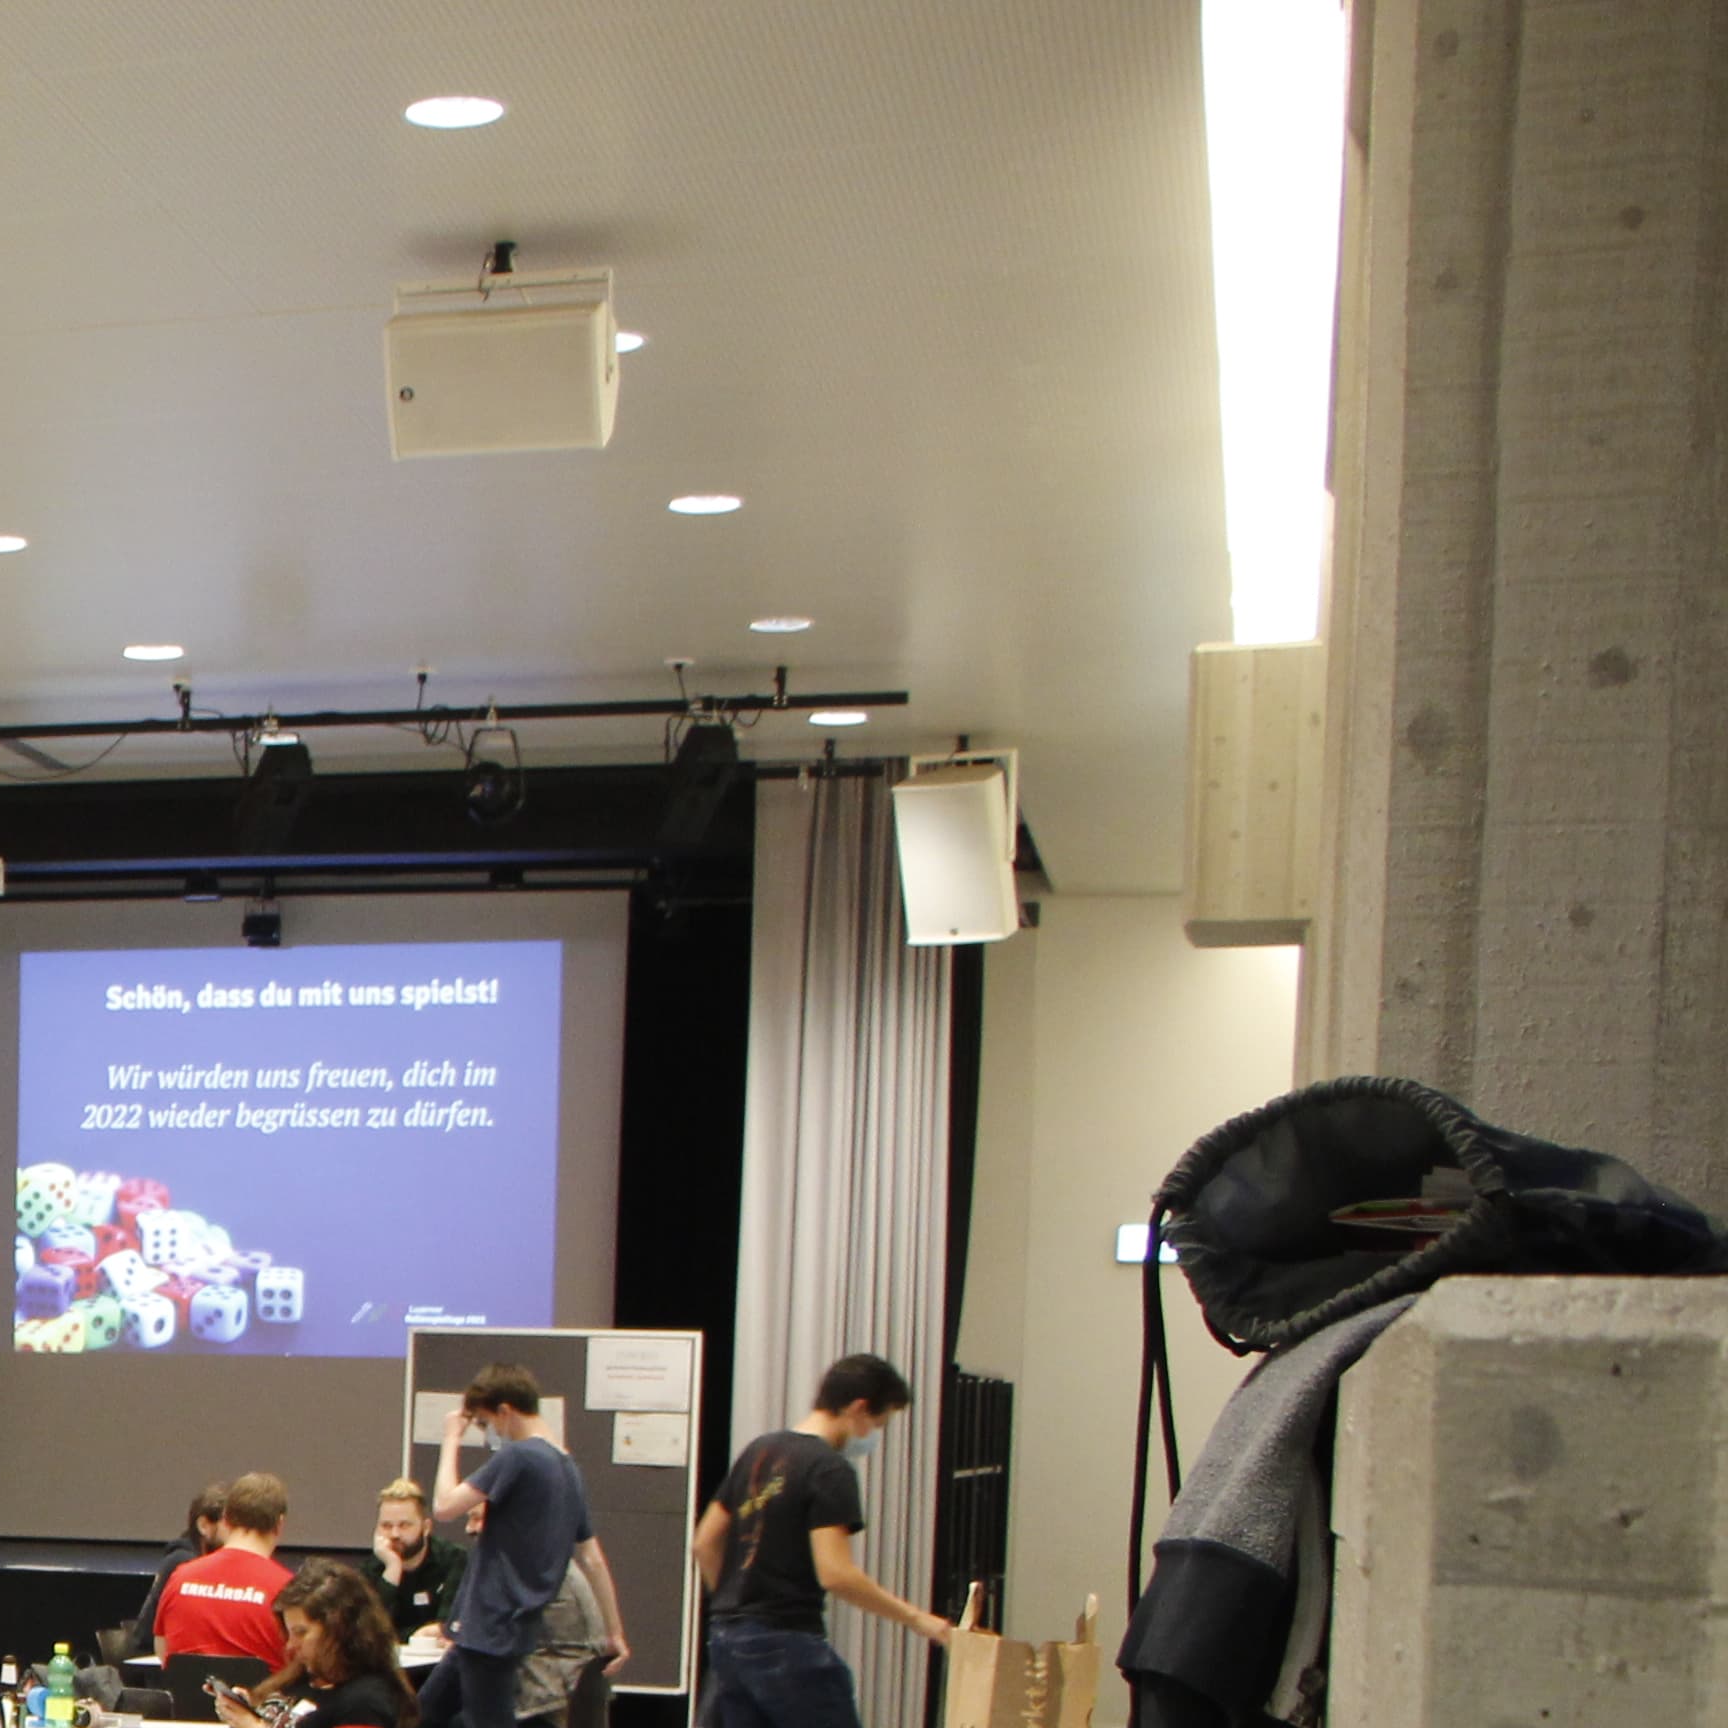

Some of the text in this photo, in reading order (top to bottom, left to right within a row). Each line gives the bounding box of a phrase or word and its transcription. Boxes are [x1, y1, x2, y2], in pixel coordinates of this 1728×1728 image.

[105, 978, 499, 1014] Schön, dass du mit uns spielst!
[107, 1061, 496, 1093] Wir würden uns freuen, dich im
[80, 1101, 494, 1134] 2022 wieder begrüssen zu dürfen.
[179, 1582, 266, 1605] ERKLÄRBÄR
